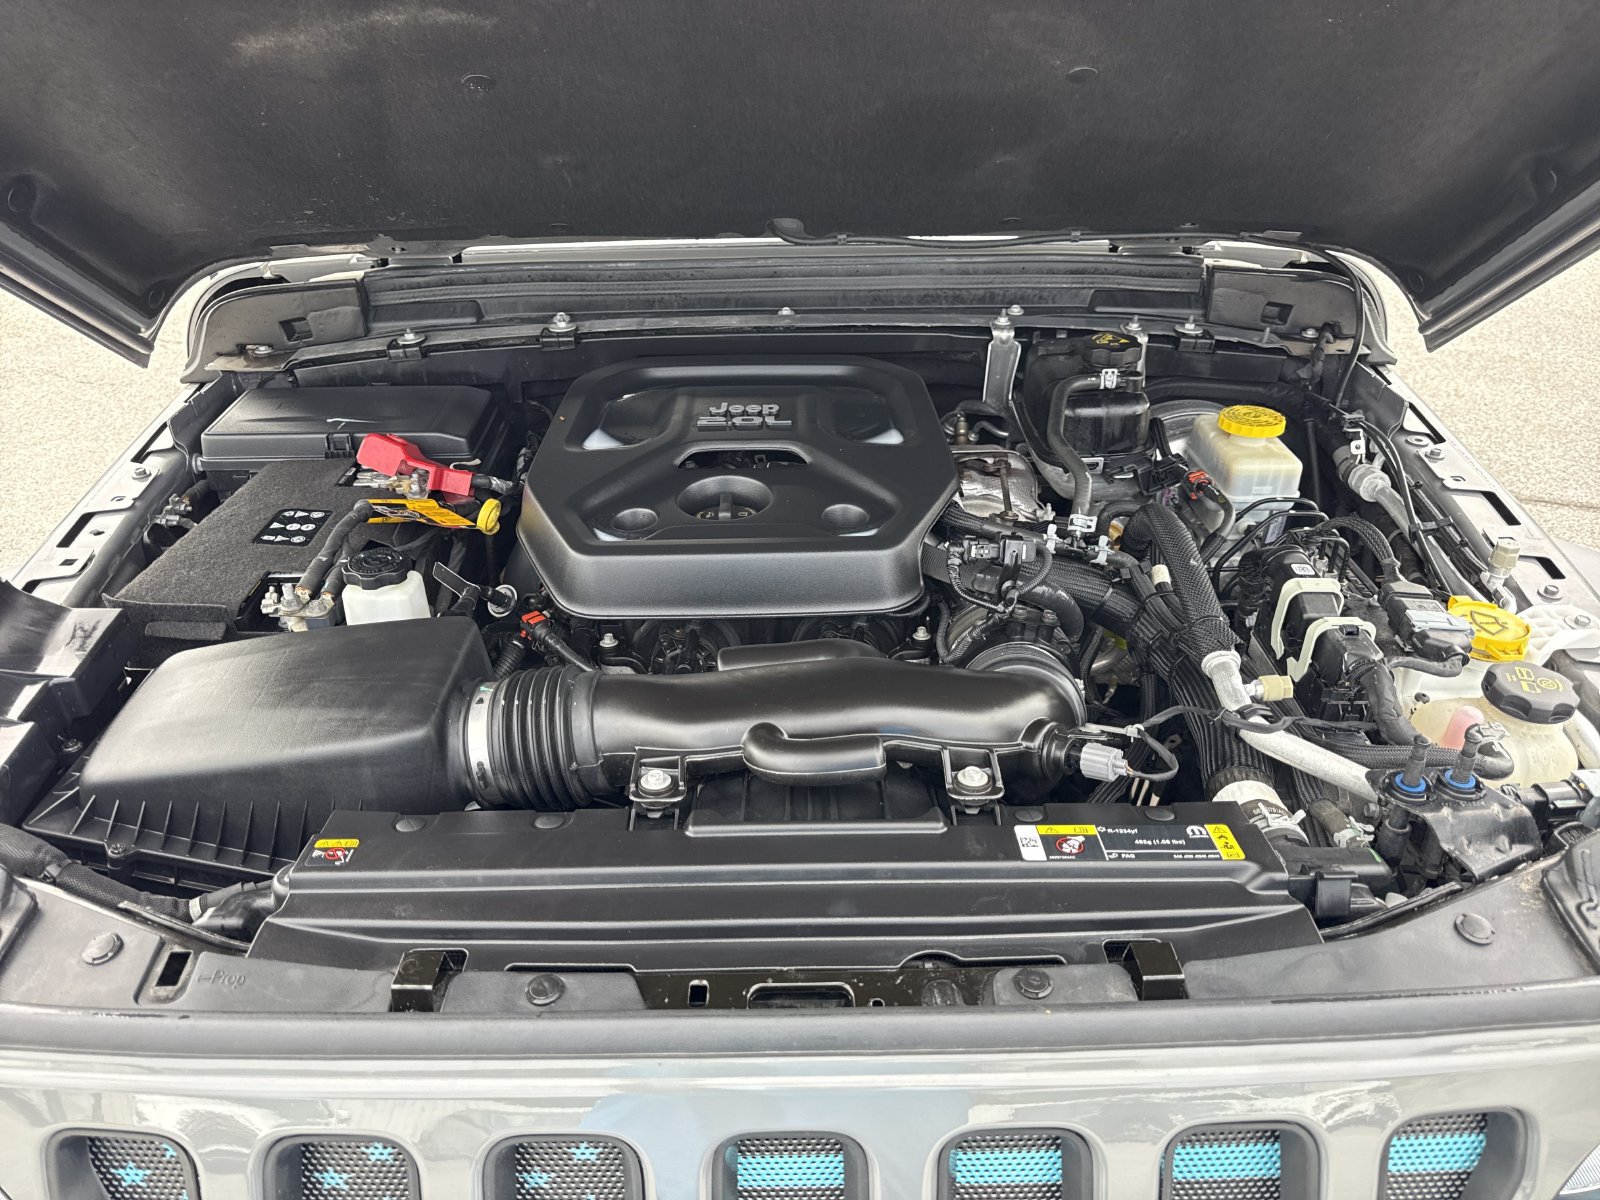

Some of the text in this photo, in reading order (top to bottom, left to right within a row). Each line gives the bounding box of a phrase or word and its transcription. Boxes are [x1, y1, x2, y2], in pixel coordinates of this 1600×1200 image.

[709, 402, 780, 415] Jeep
[697, 416, 792, 429] 2.0L
[210, 968, 246, 989] Prop
